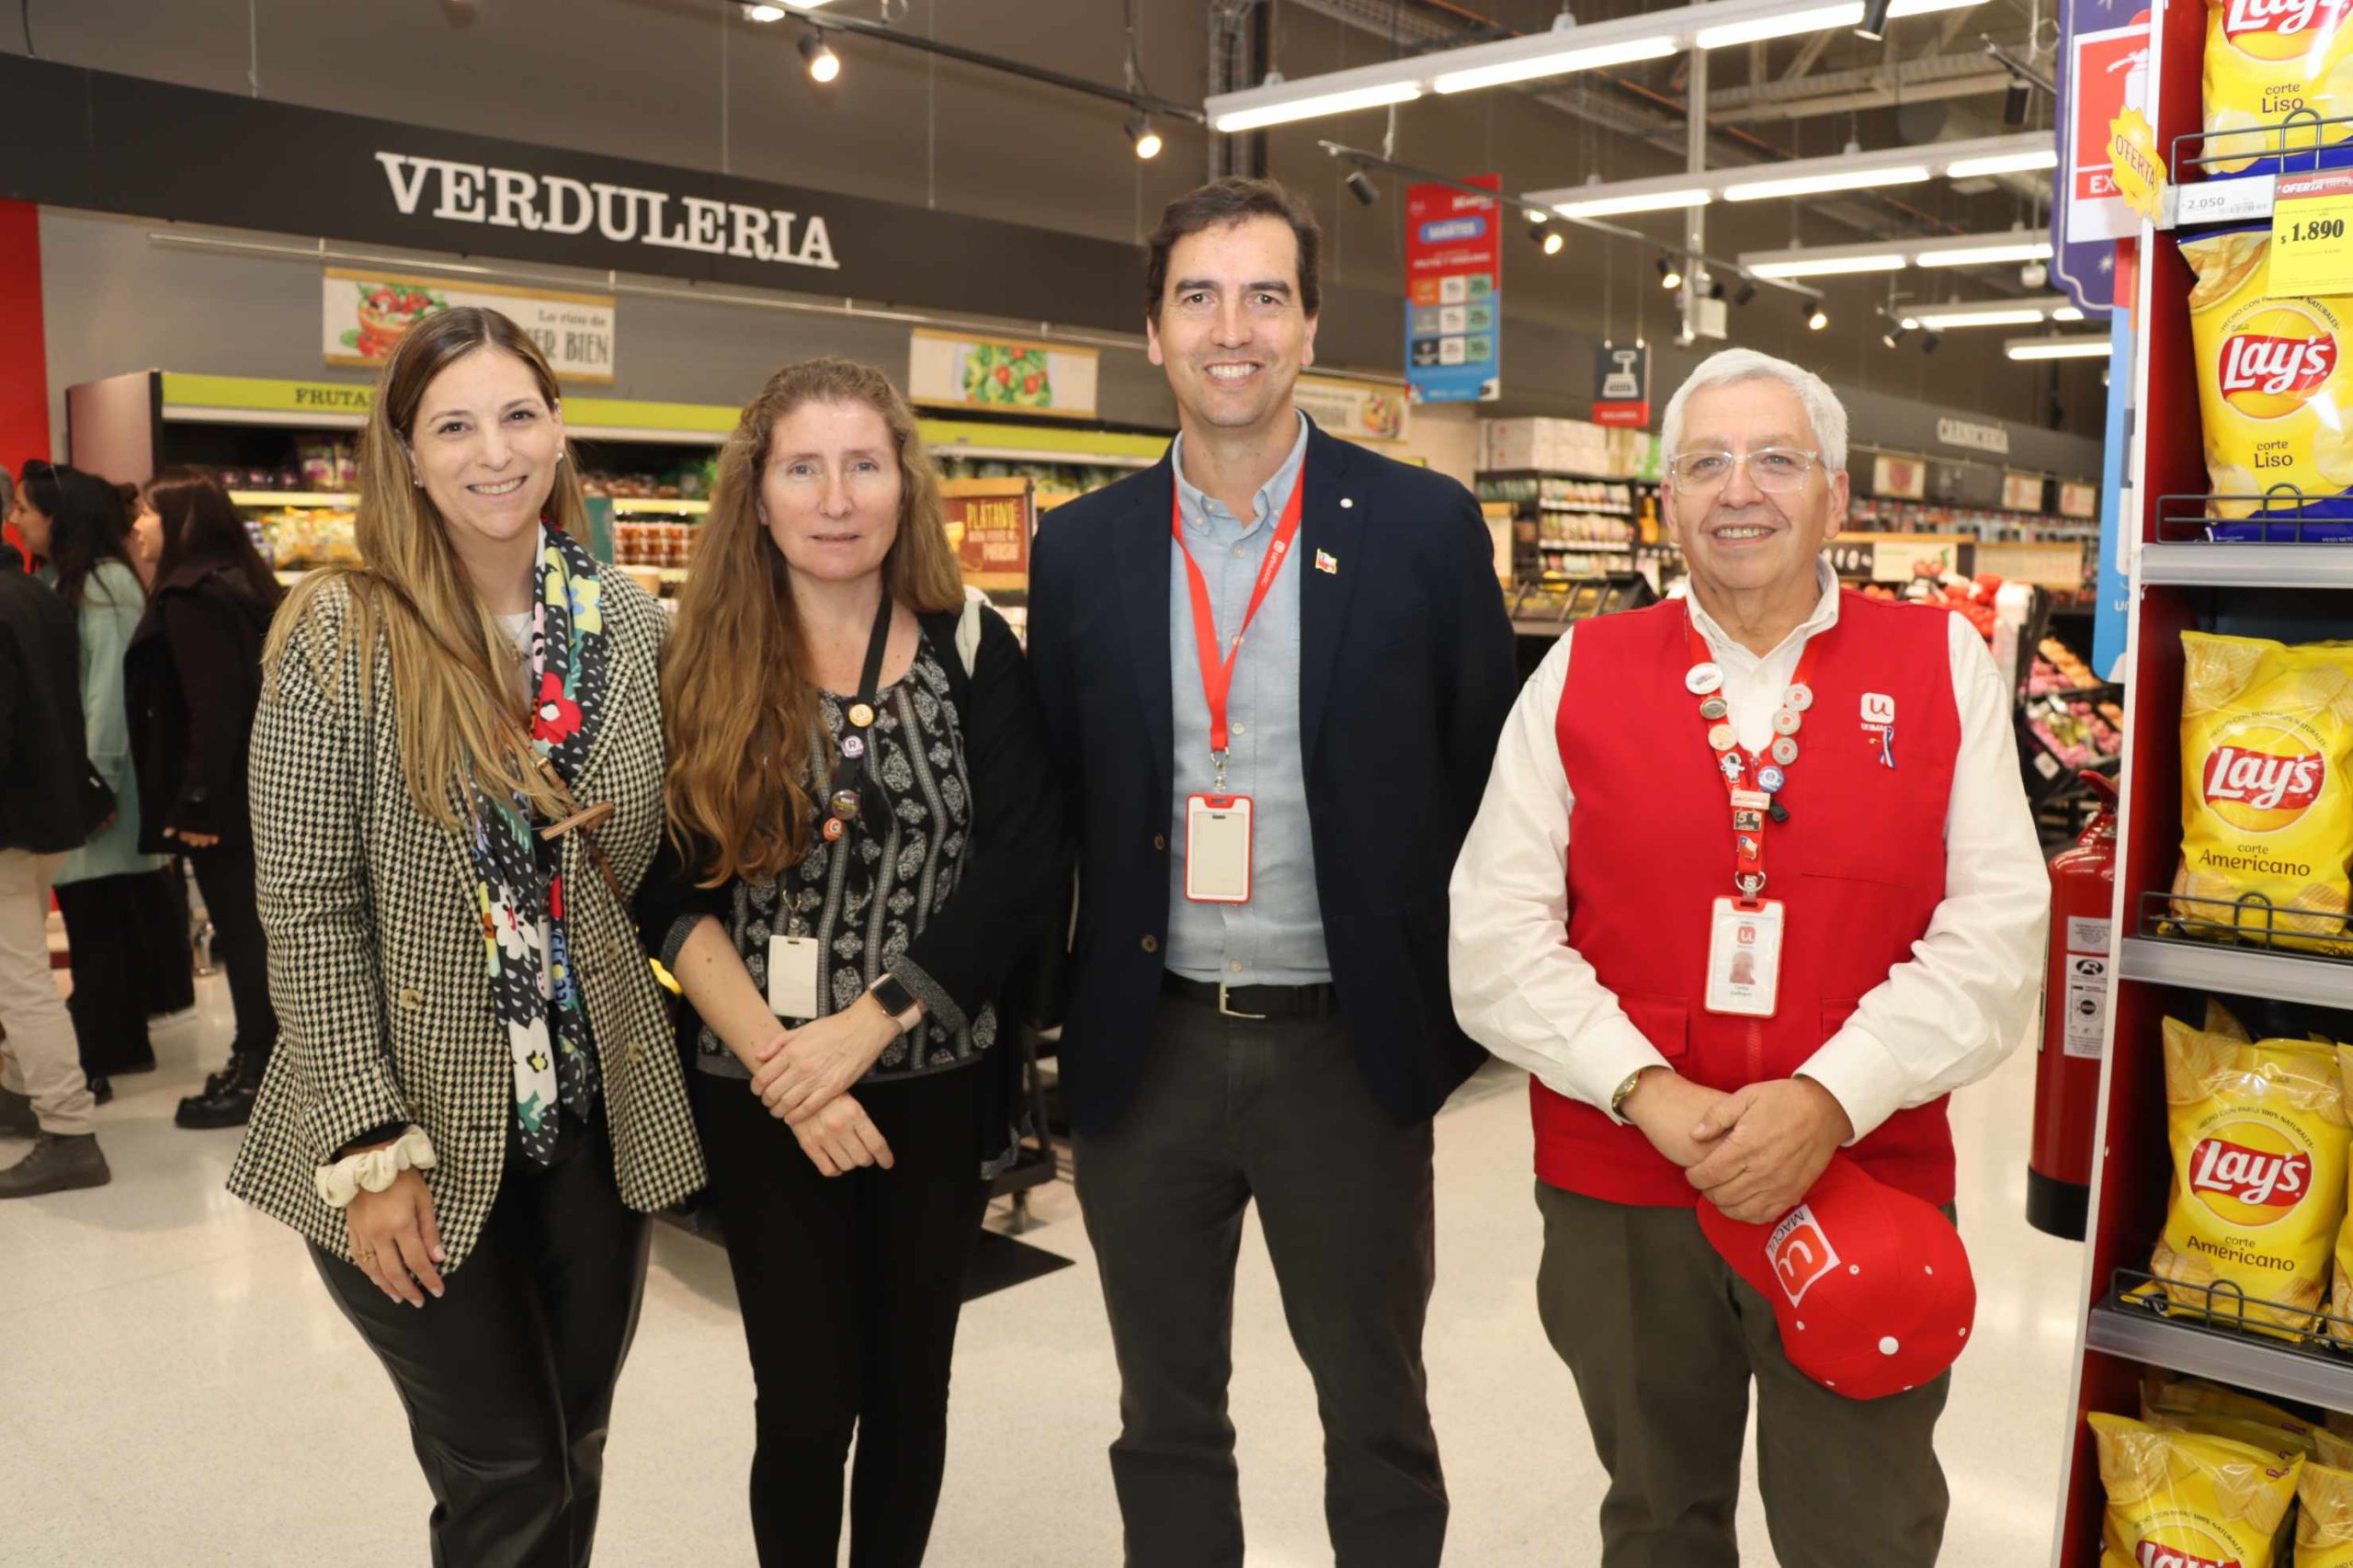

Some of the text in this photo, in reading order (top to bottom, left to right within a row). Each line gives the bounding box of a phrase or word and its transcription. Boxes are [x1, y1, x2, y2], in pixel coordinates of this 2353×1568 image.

[2262, 97, 2304, 113] Liso
[2265, 84, 2301, 96] corte
[2115, 134, 2155, 191] OFERTA
[375, 152, 839, 269] VERDULERIA
[2291, 219, 2345, 242] 1.890
[2223, 335, 2331, 395] Lay's
[2254, 451, 2293, 469] Liso
[2256, 440, 2289, 452] corte
[2207, 748, 2319, 810] Lay's
[2199, 848, 2311, 878] Americano
[2237, 844, 2269, 856] corte
[2262, 1109, 2279, 1119] 100%
[2280, 1114, 2314, 1148] NATURALES
[2195, 1141, 2306, 1205] Lay's
[2187, 1235, 2295, 1272] Americano
[2224, 1235, 2256, 1248] corte
